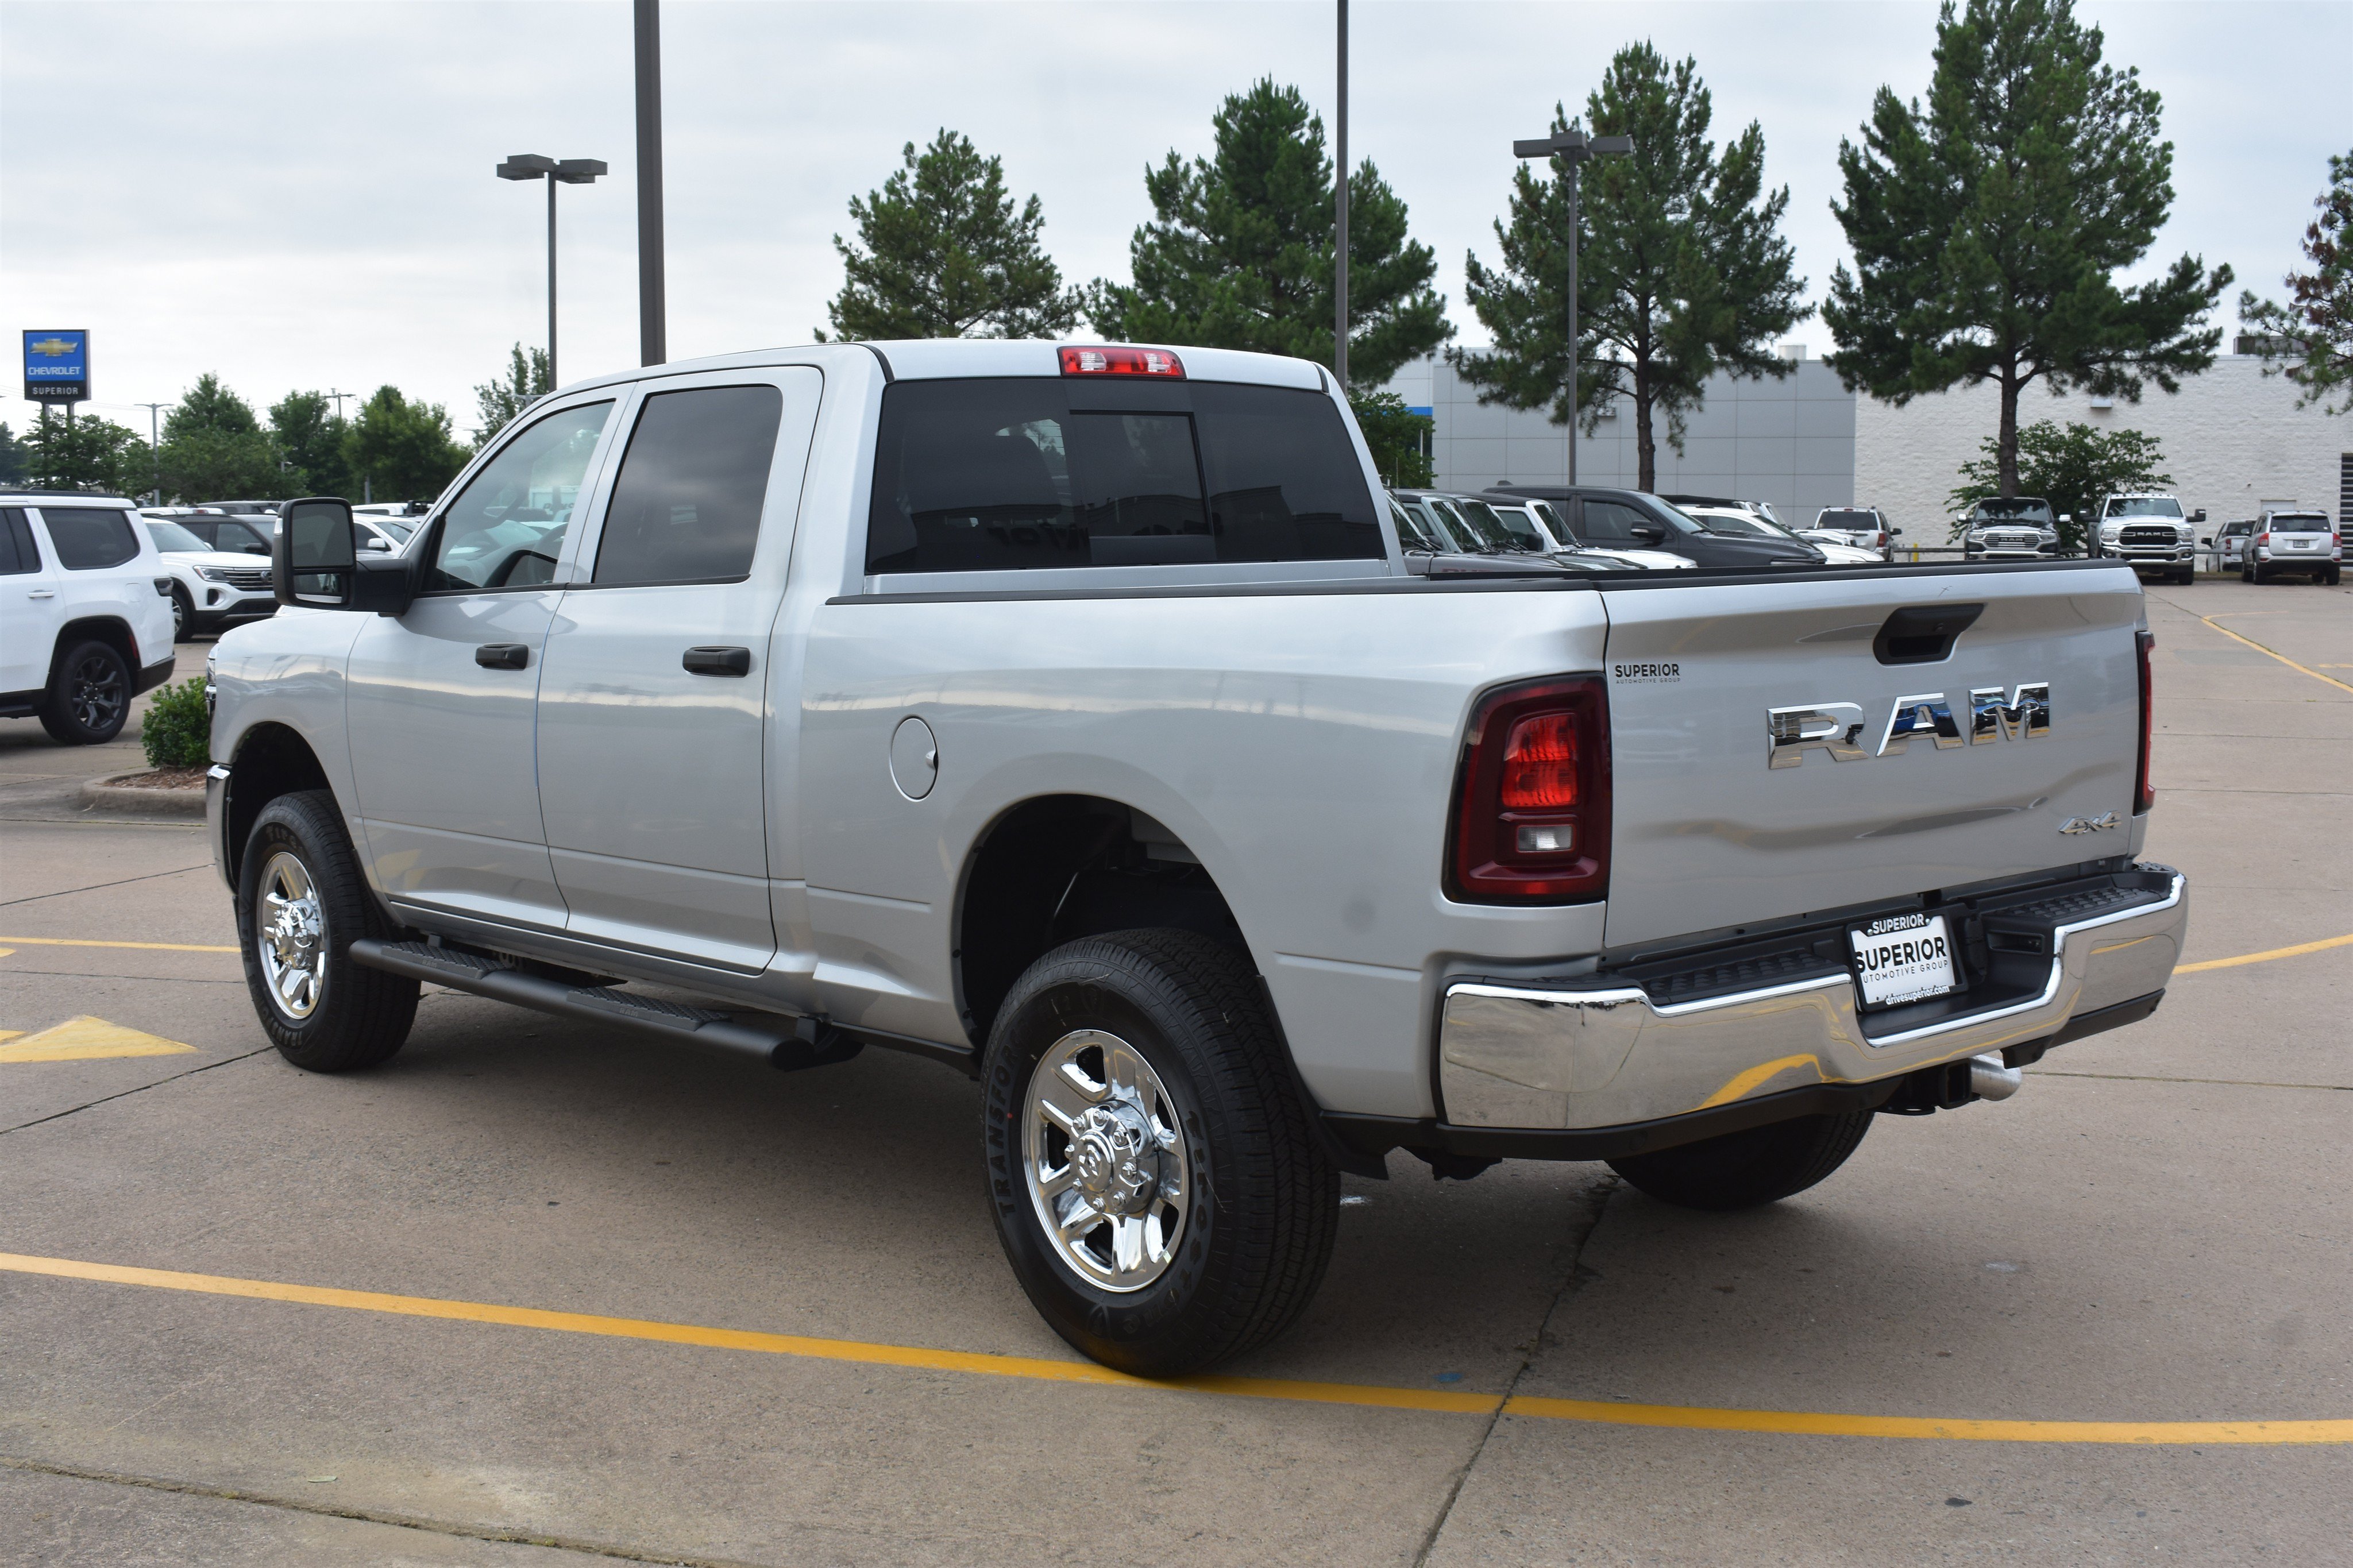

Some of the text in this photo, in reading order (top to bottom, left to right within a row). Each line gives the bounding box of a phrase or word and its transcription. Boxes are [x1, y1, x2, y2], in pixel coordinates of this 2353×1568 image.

[29, 367, 80, 375] CHEVROLET
[33, 387, 78, 395] SUPERIOR
[1615, 663, 1680, 678] SUPERIOR
[1768, 681, 2049, 770] RAM
[1872, 913, 1924, 934] SUPERIOR
[1855, 936, 1947, 974] SUPERIOR
[1862, 960, 1949, 983] UTOMOTIVE GROUP
[1885, 984, 1950, 1005] drivesuperior.com
